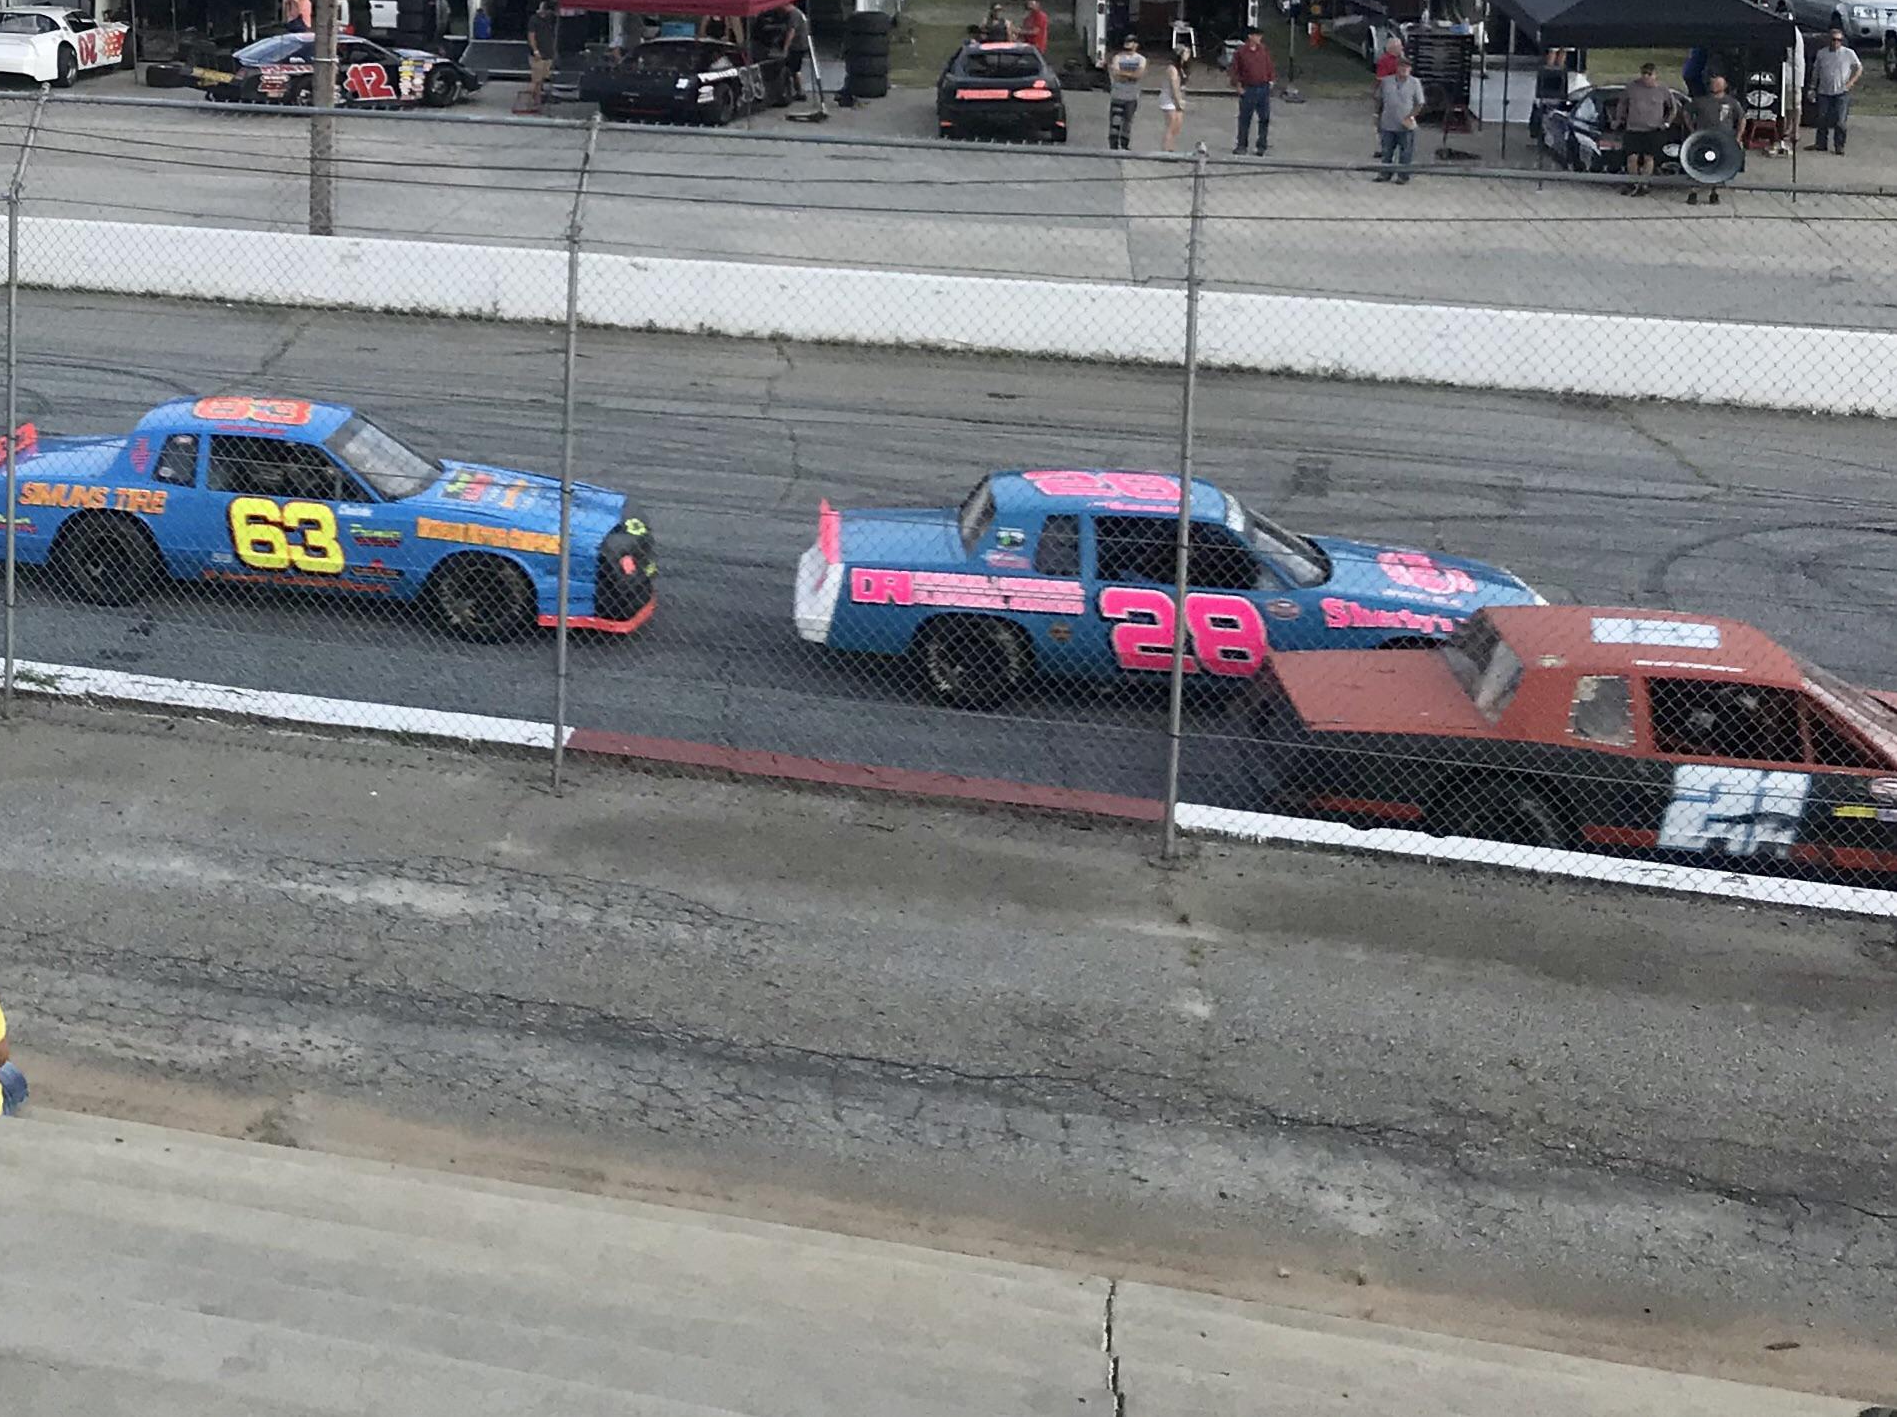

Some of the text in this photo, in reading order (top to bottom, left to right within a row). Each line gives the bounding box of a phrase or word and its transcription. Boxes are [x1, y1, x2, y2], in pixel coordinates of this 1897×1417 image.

[192, 395, 311, 425] 63
[228, 494, 346, 575] 63
[1102, 586, 1268, 678] 28
